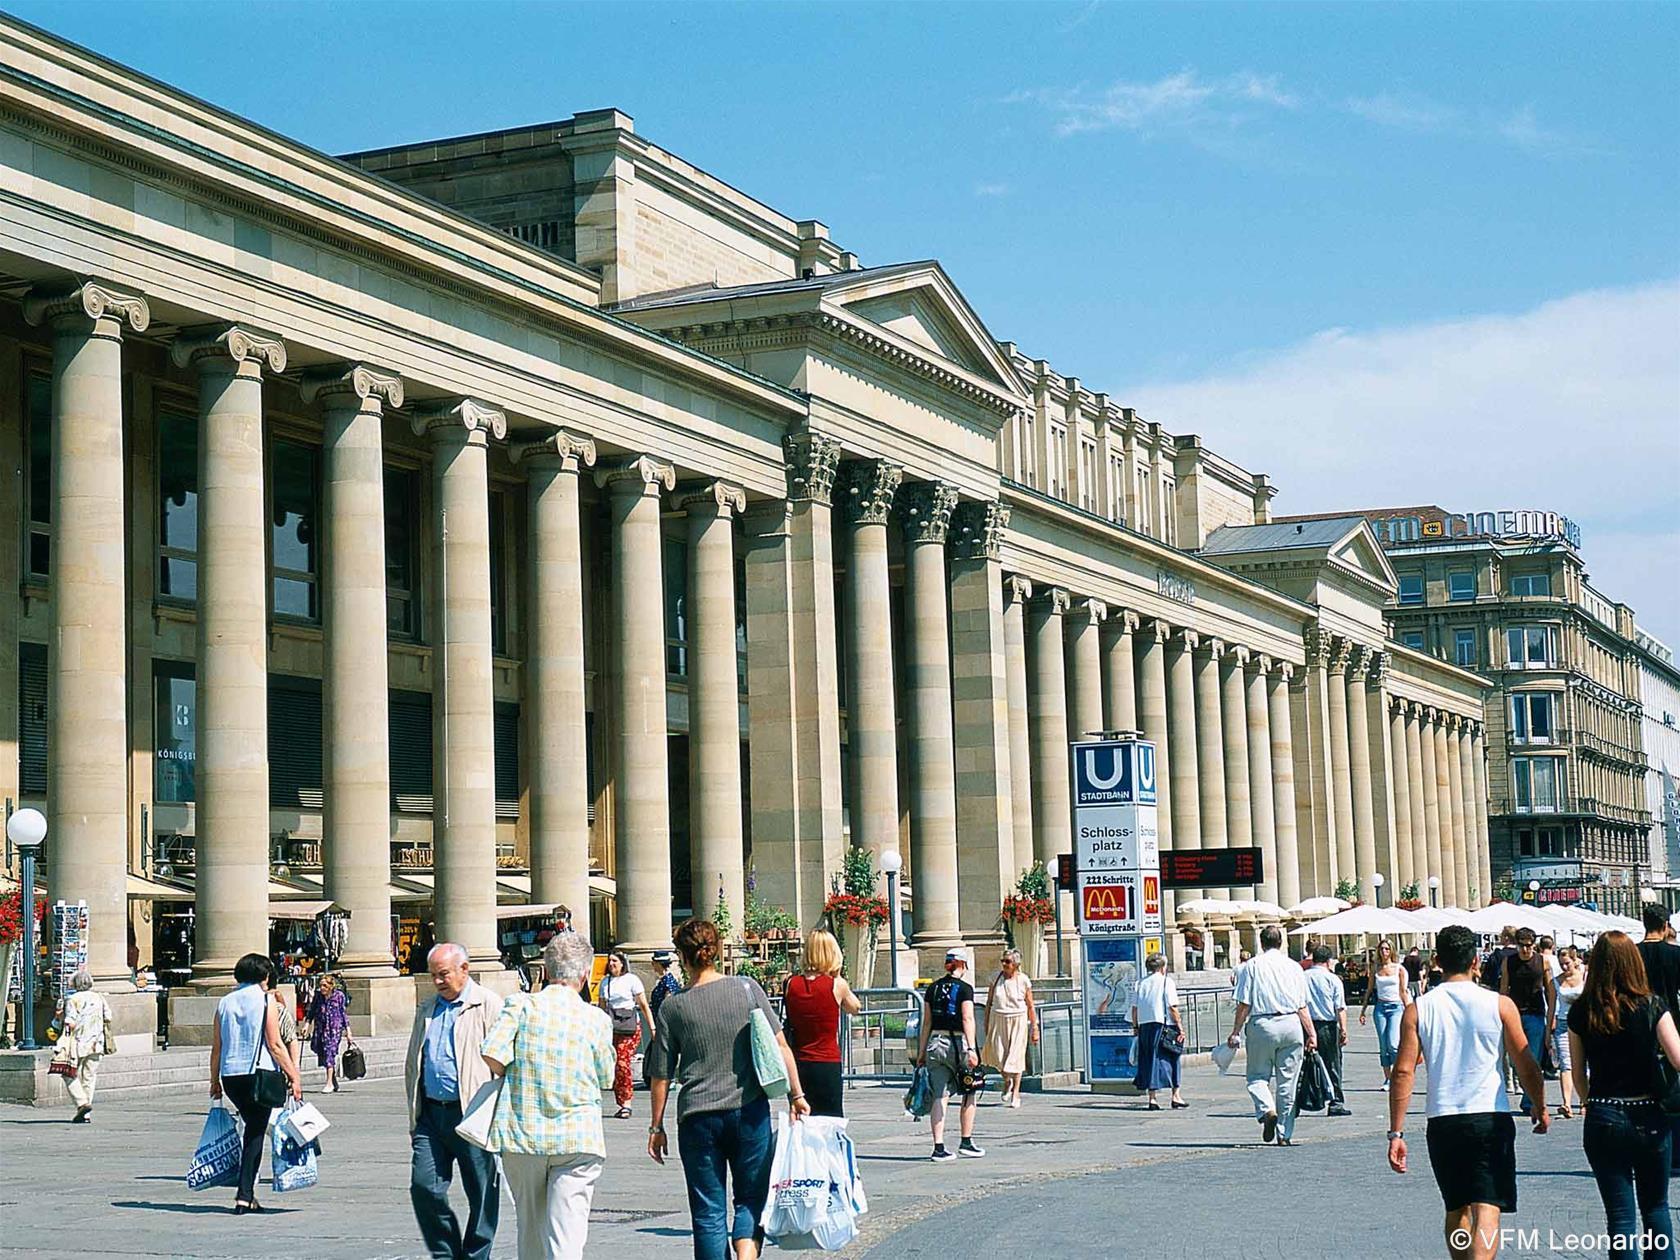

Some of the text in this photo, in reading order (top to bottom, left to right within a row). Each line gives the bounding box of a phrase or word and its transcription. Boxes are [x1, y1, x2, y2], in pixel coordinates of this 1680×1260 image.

[1443, 511, 1558, 537] CINEMA
[1085, 748, 1123, 790] U
[1081, 791, 1130, 800] STADTBAHN
[1080, 827, 1133, 838] Schloss-
[1092, 840, 1122, 853] platz
[1086, 876, 1135, 884] 222 Schritte
[1089, 923, 1136, 934] Königstraße
